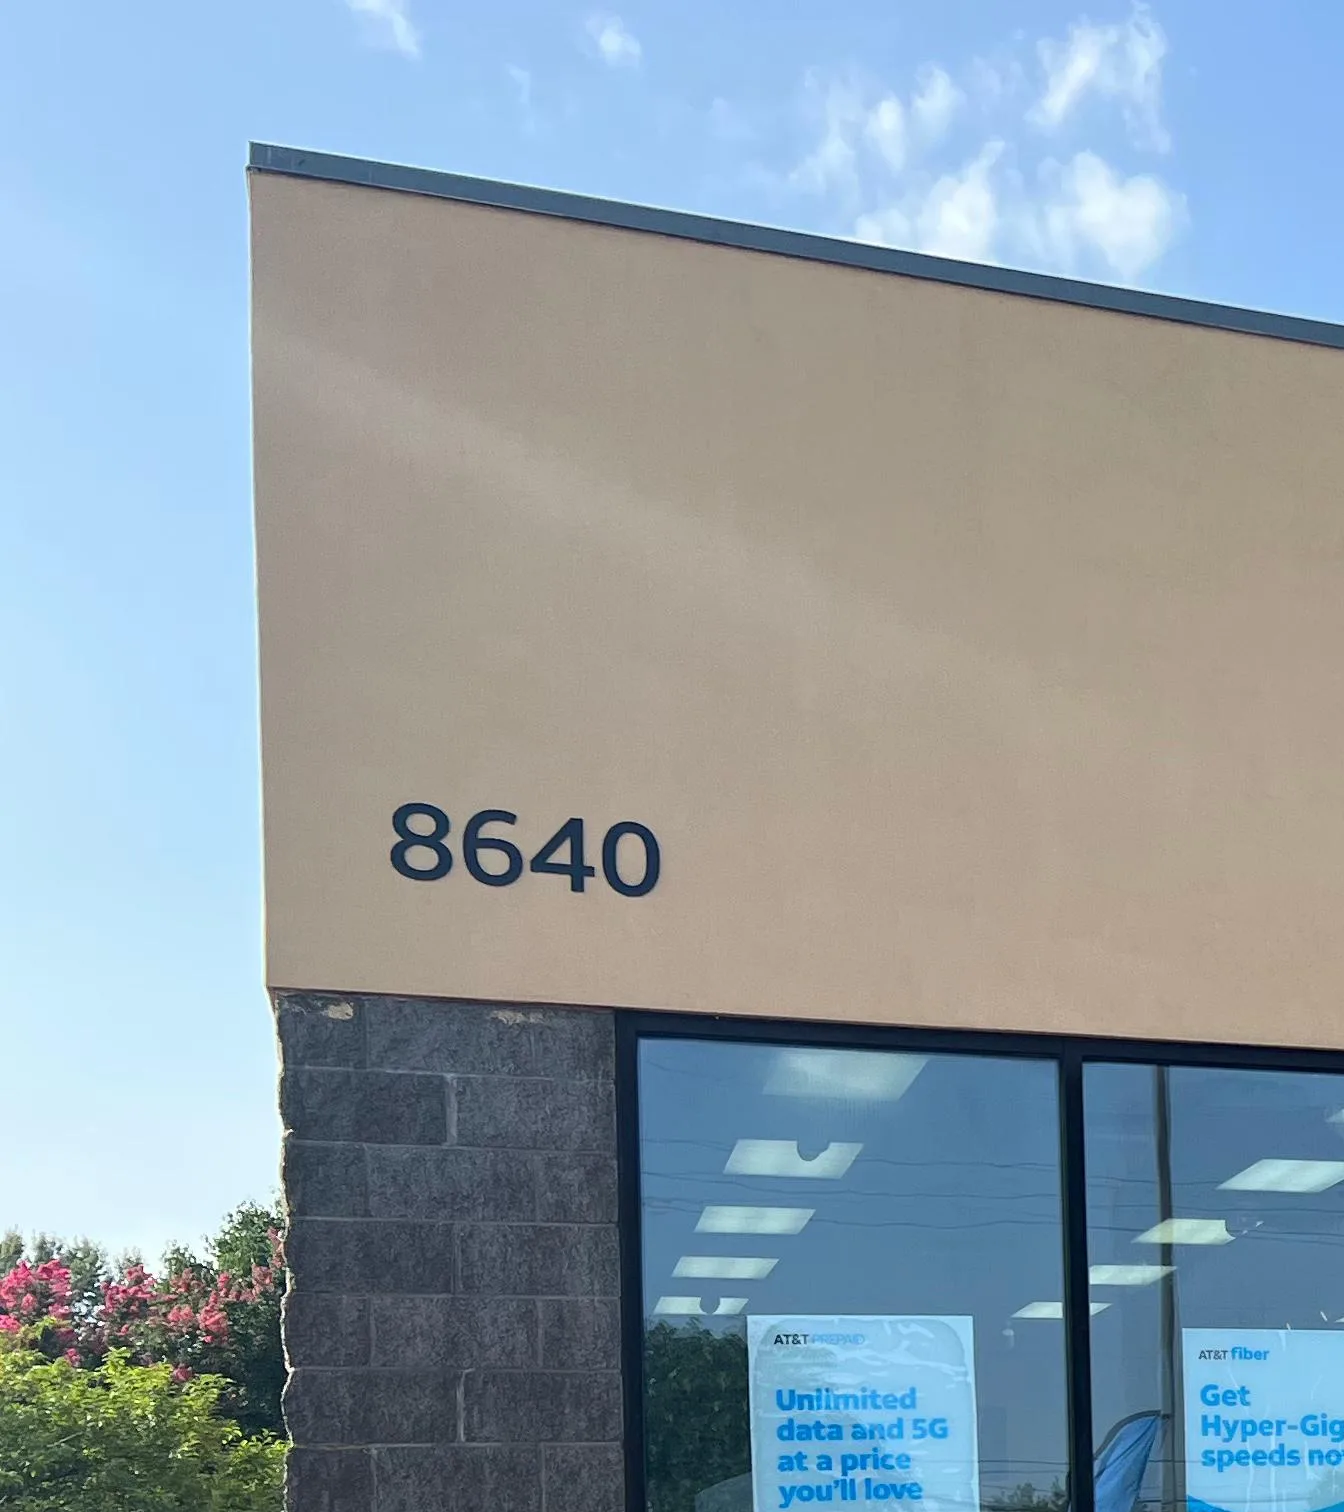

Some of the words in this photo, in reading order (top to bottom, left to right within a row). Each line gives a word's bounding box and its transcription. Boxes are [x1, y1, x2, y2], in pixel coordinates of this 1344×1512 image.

[390, 802, 660, 897] 8640
[773, 1333, 809, 1345] AT&T
[811, 1333, 865, 1345] PREPAID
[1198, 1350, 1228, 1360] AT&T
[1231, 1347, 1270, 1360] fiber
[776, 1387, 917, 1411] Unlimited
[1200, 1384, 1251, 1406] Get
[777, 1418, 843, 1441] data
[851, 1417, 904, 1441] and
[912, 1418, 948, 1440] 5G
[777, 1451, 808, 1472] at
[816, 1454, 833, 1471] a
[841, 1448, 911, 1476] price
[1201, 1443, 1300, 1473] speeds
[778, 1478, 856, 1509] you'll
[865, 1478, 923, 1500] love
